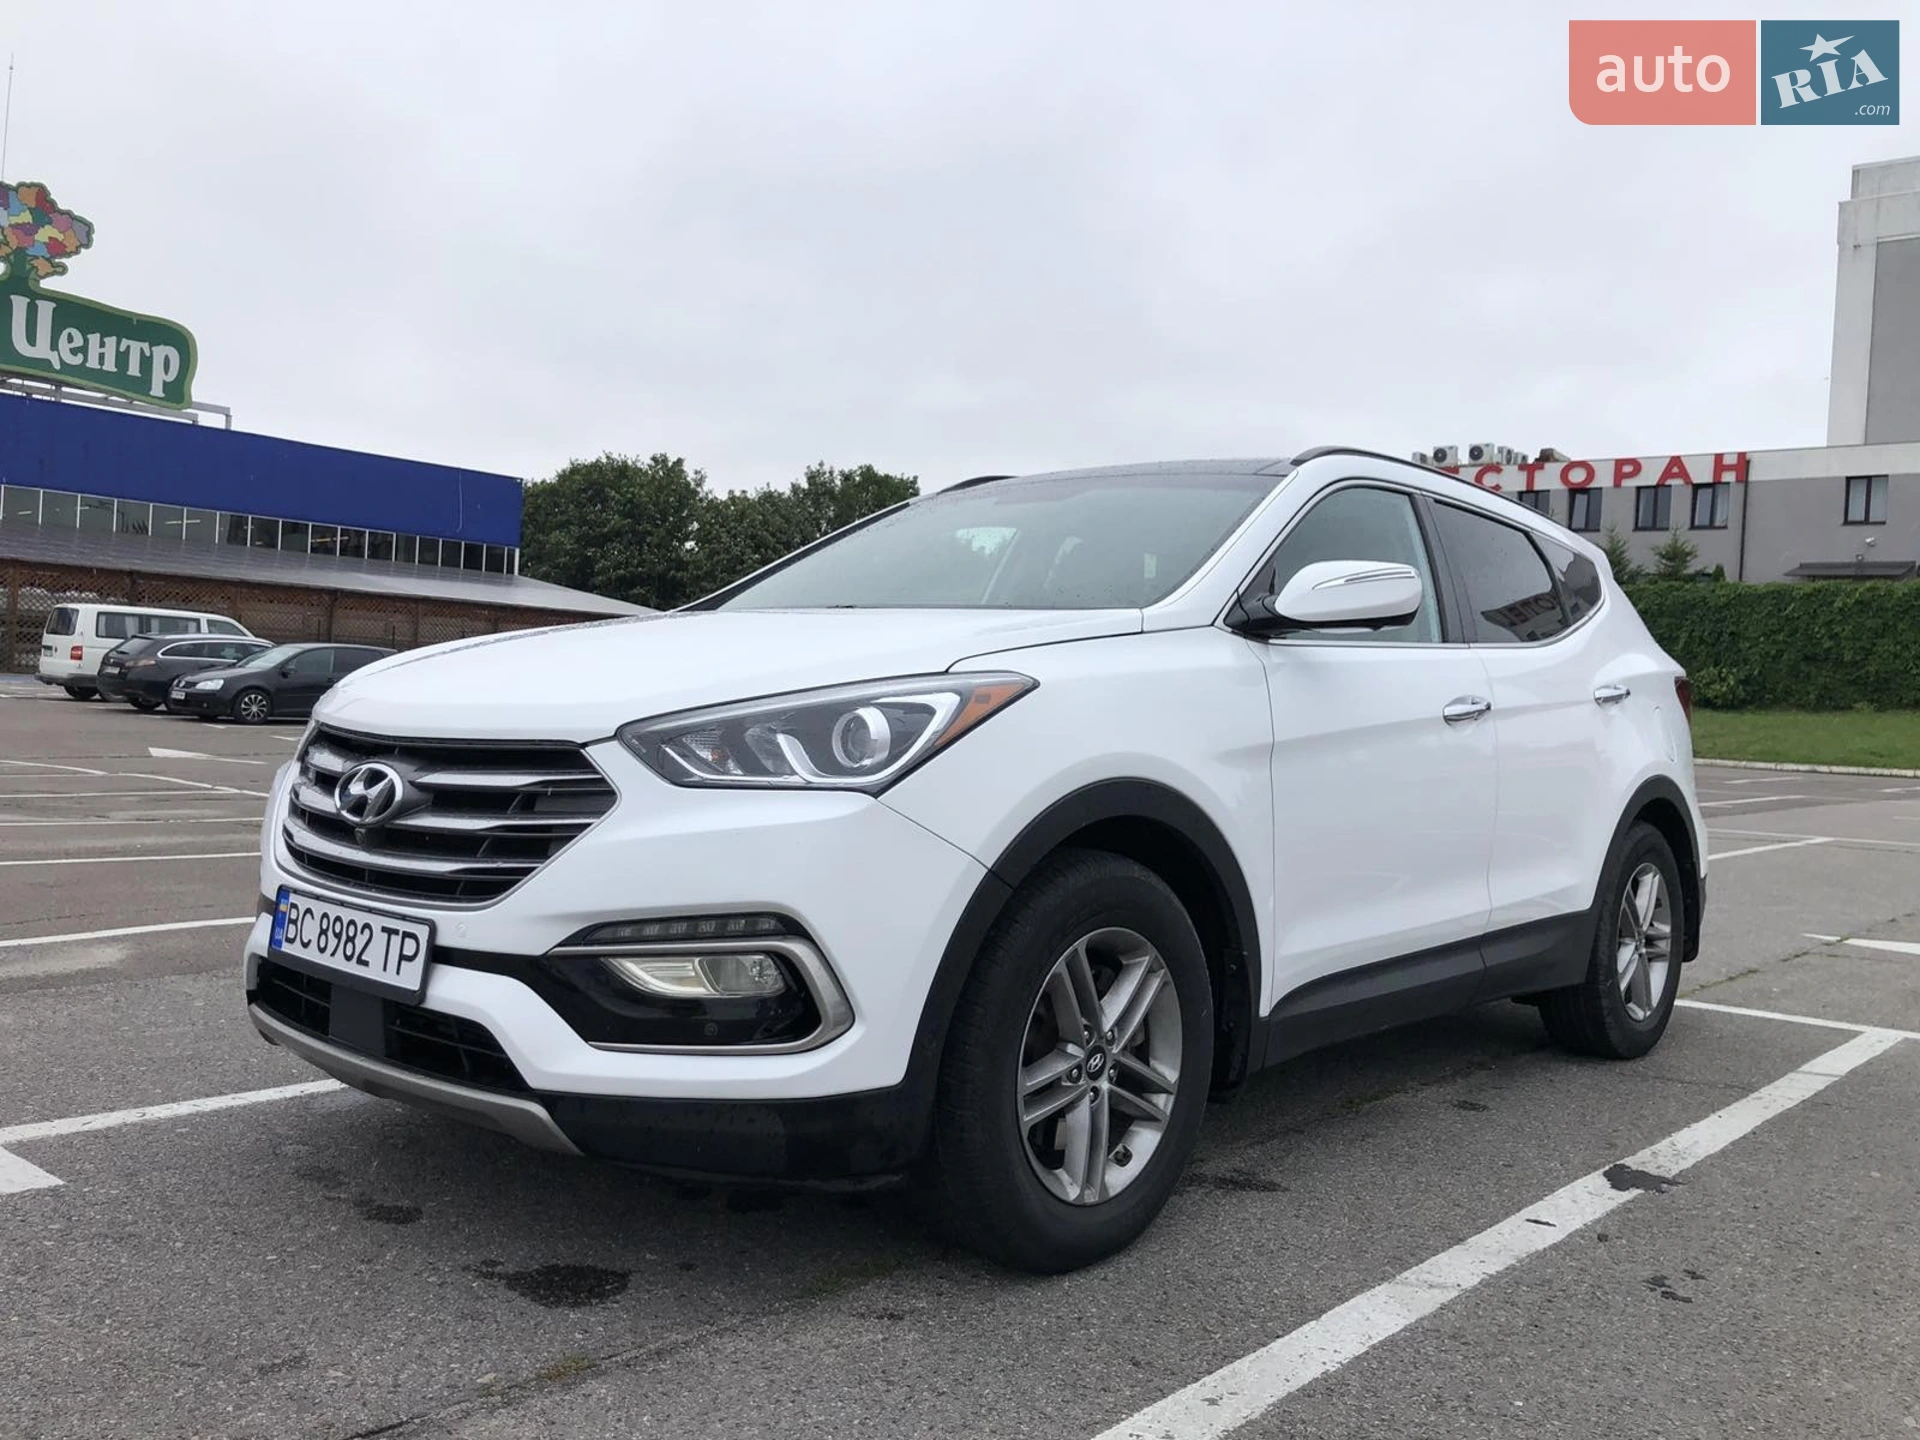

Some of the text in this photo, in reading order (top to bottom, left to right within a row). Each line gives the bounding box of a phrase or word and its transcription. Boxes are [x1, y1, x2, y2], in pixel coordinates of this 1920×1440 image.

[10, 295, 180, 398] Центр
[1437, 451, 1748, 492] СТОРАН
[285, 902, 421, 976] BC 8982 TP
